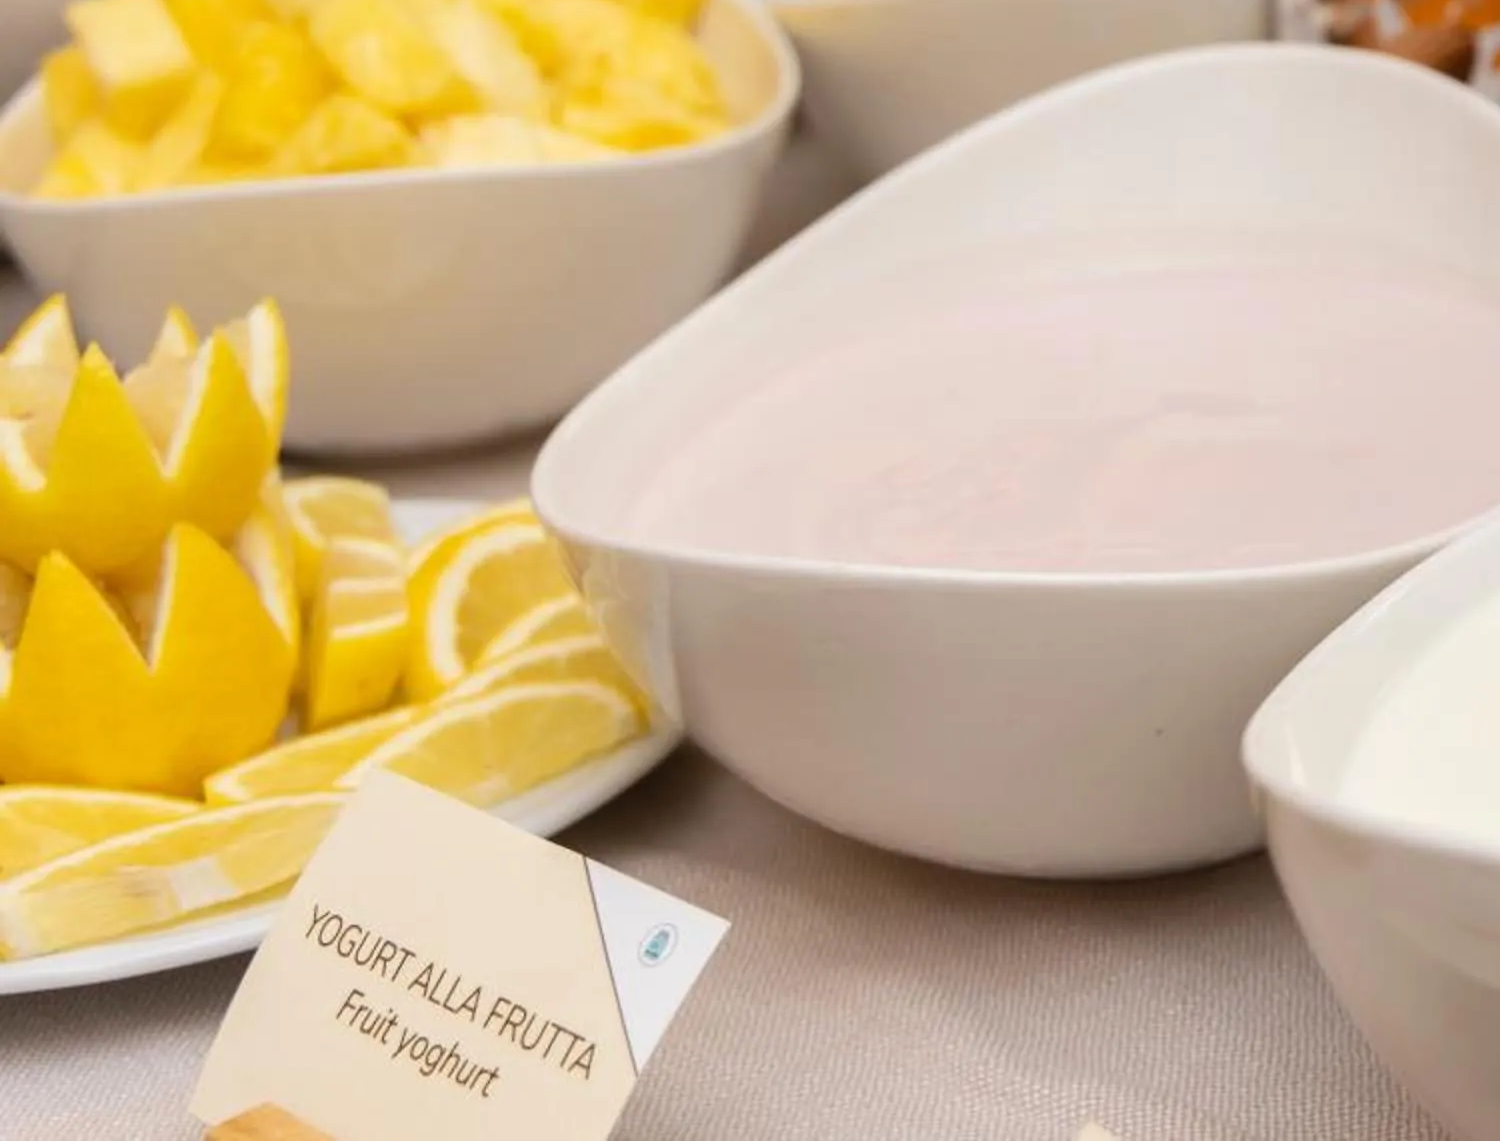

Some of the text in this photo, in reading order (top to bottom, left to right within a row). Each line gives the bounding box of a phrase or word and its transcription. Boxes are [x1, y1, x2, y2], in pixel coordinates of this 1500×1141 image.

[304, 903, 597, 1081] YOGURT ALLA FRUTTA
[336, 989, 502, 1099] Fruit yoghurt
